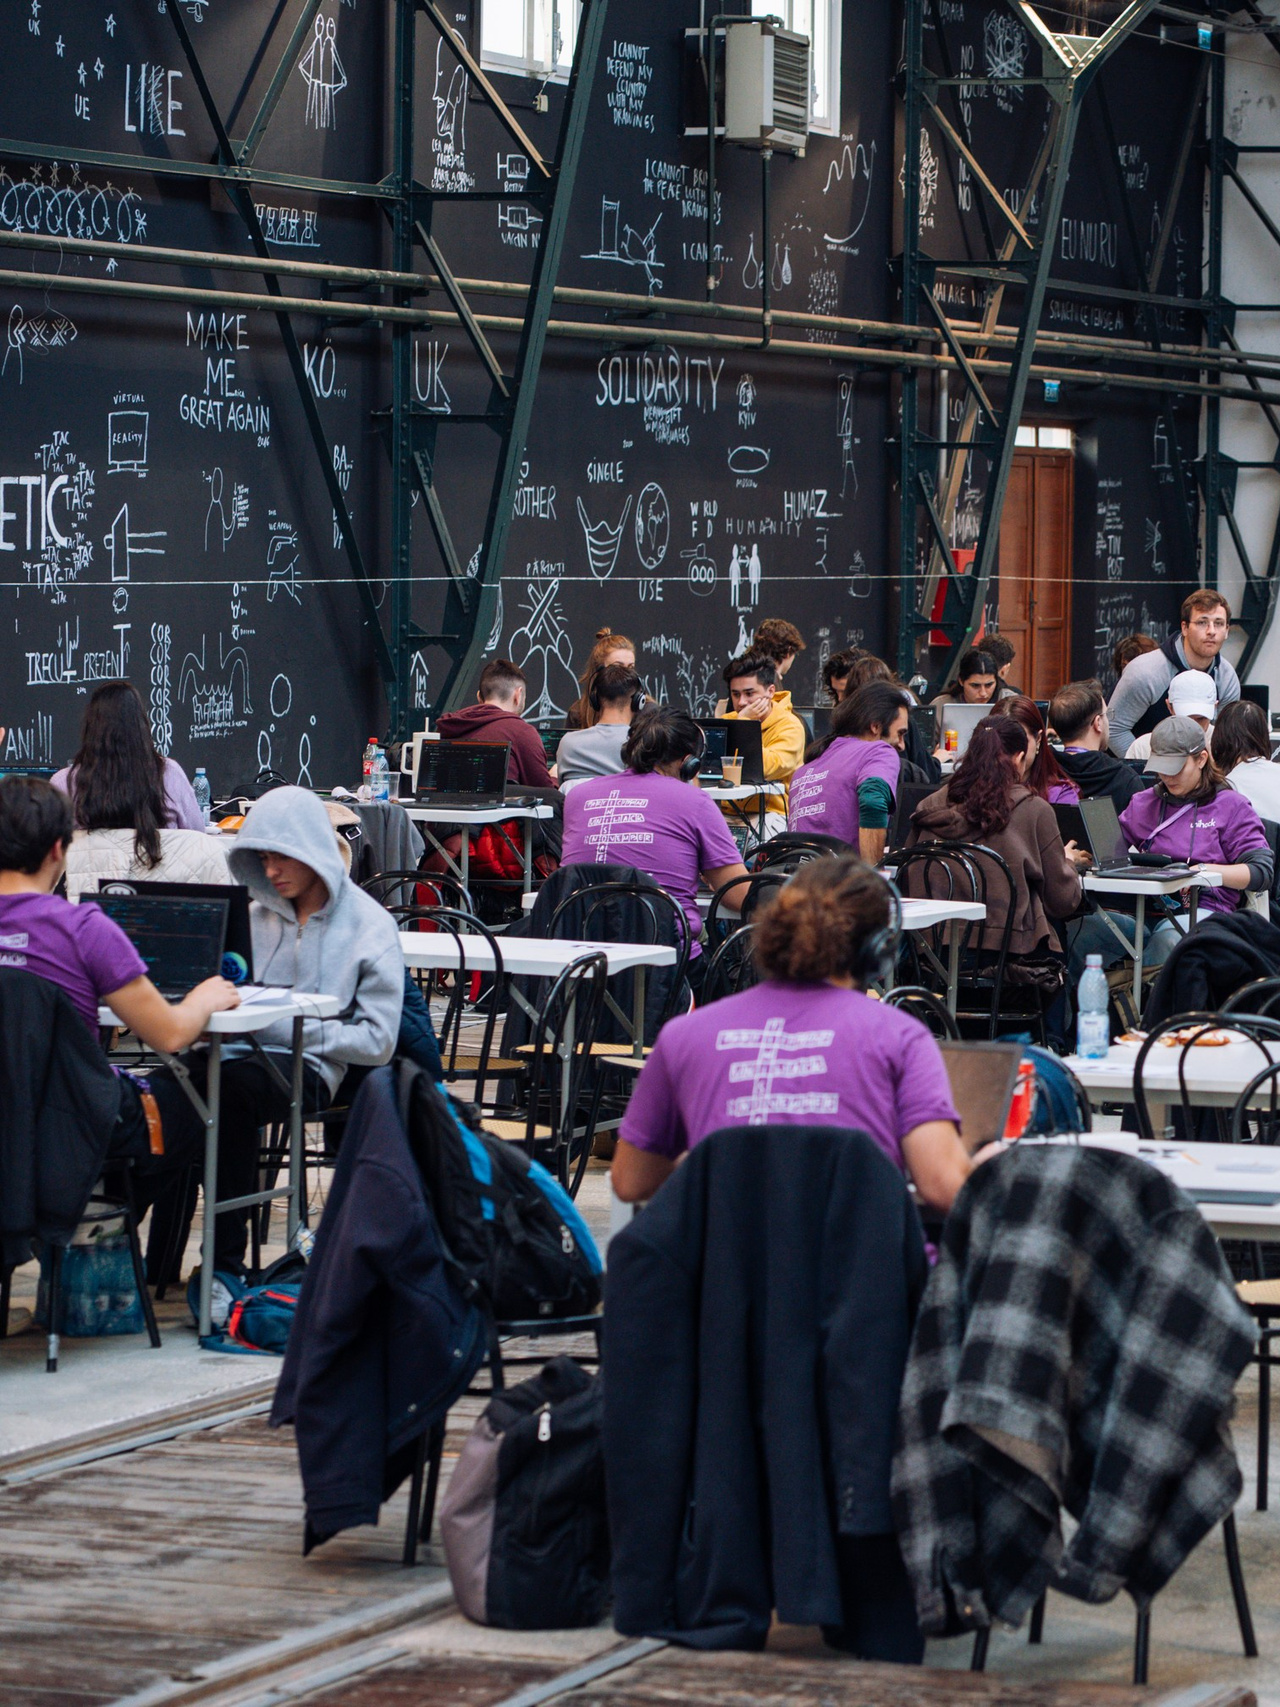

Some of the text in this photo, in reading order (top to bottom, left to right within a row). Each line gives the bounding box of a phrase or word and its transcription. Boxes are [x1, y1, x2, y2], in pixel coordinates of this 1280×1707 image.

[28, 19, 40, 35] UK
[618, 42, 649, 60] CANNOT
[606, 57, 653, 82] DEFEND MY
[616, 76, 648, 99] COUNTRY
[75, 93, 91, 121] UE
[607, 92, 643, 112] WITH MY
[613, 109, 654, 133] DRAWINGS
[651, 160, 690, 185] CANNOT
[643, 177, 654, 194] THE
[959, 184, 972, 211] NO
[186, 311, 249, 351] MAKE
[415, 340, 451, 403] UK
[596, 355, 725, 412] SOLIDARITY
[113, 391, 145, 405] VIRTUAL
[180, 394, 270, 434] GREAT AGAIN
[738, 411, 757, 430] KYIV
[53, 431, 70, 447] TAC
[112, 431, 143, 447] REALITY
[40, 443, 60, 471] TAC
[587, 457, 624, 484] SINGLE
[639, 579, 664, 602] USE
[150, 622, 172, 643] COR
[150, 664, 172, 687] COR
[150, 686, 172, 707] COR
